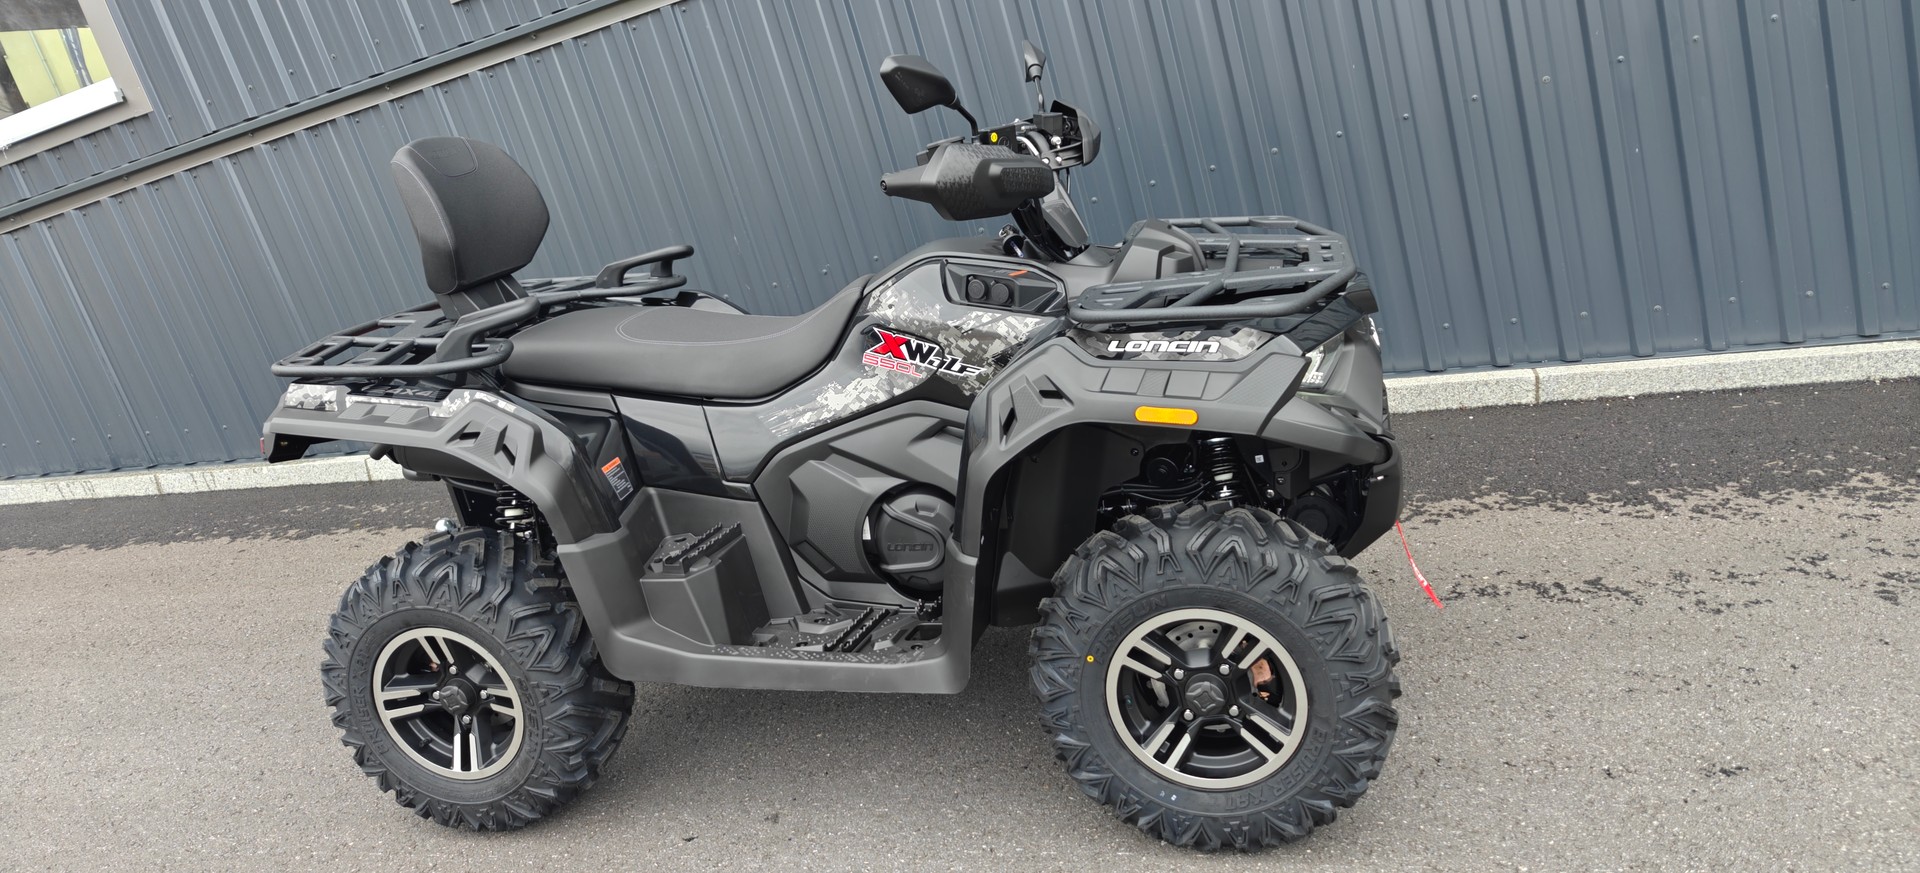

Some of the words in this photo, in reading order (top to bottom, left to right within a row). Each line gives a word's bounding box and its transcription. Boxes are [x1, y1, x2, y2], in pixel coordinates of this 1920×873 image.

[1107, 340, 1221, 353] LONCIN
[887, 542, 934, 552] LONCIN
[1265, 726, 1329, 797] BRUISER
